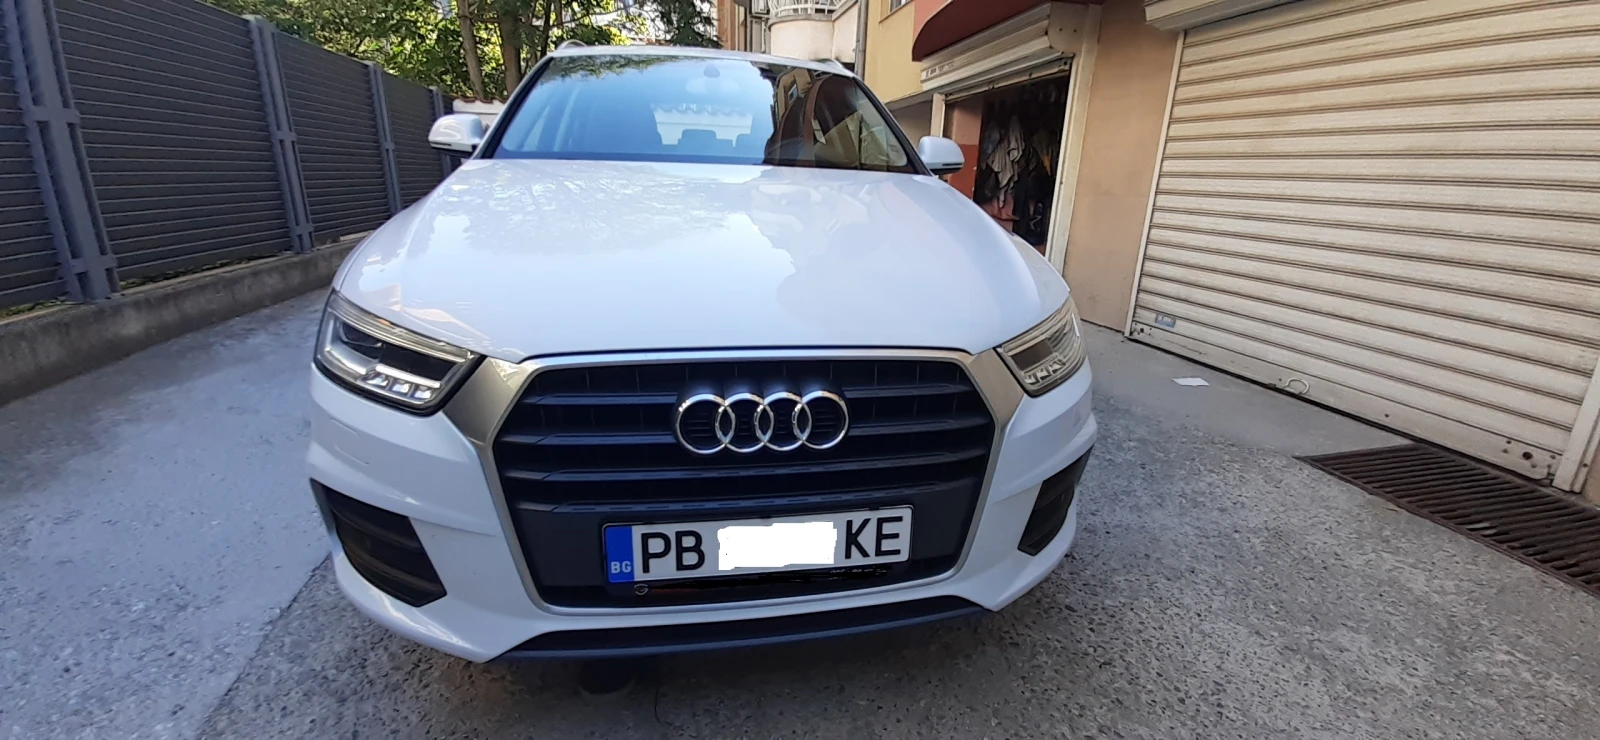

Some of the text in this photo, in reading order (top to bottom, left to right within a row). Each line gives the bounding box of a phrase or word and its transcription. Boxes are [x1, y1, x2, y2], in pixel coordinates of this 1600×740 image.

[641, 515, 903, 574] PB KE
[610, 561, 632, 573] BG
